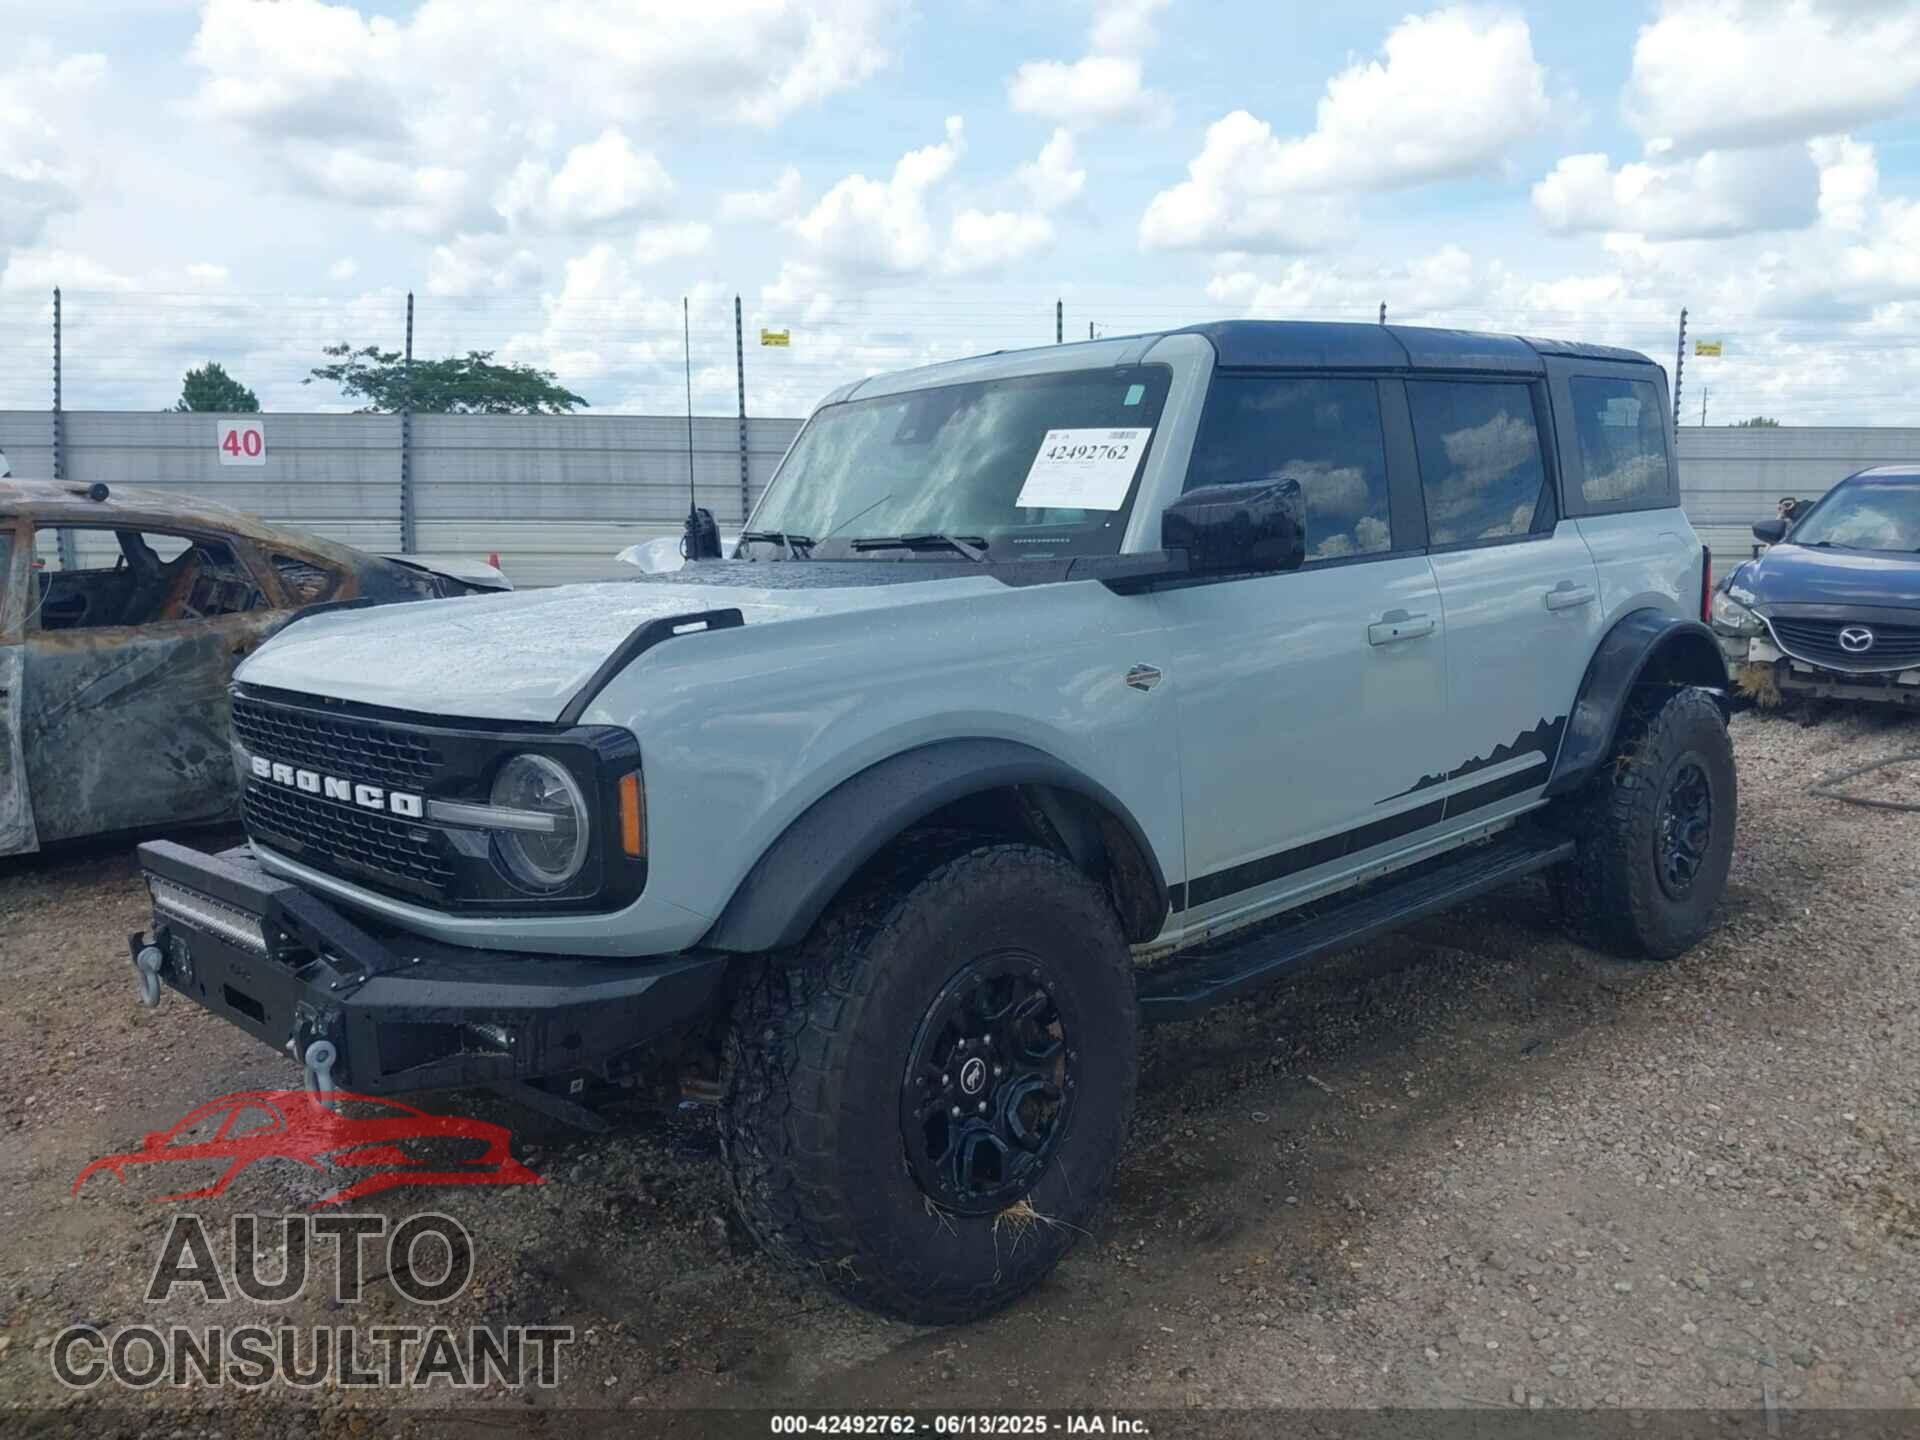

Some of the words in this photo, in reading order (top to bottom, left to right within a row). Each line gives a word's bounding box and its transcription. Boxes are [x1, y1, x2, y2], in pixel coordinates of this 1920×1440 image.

[223, 430, 262, 456] 40
[1047, 445, 1129, 460] 42492762
[252, 756, 423, 818] BRONCO
